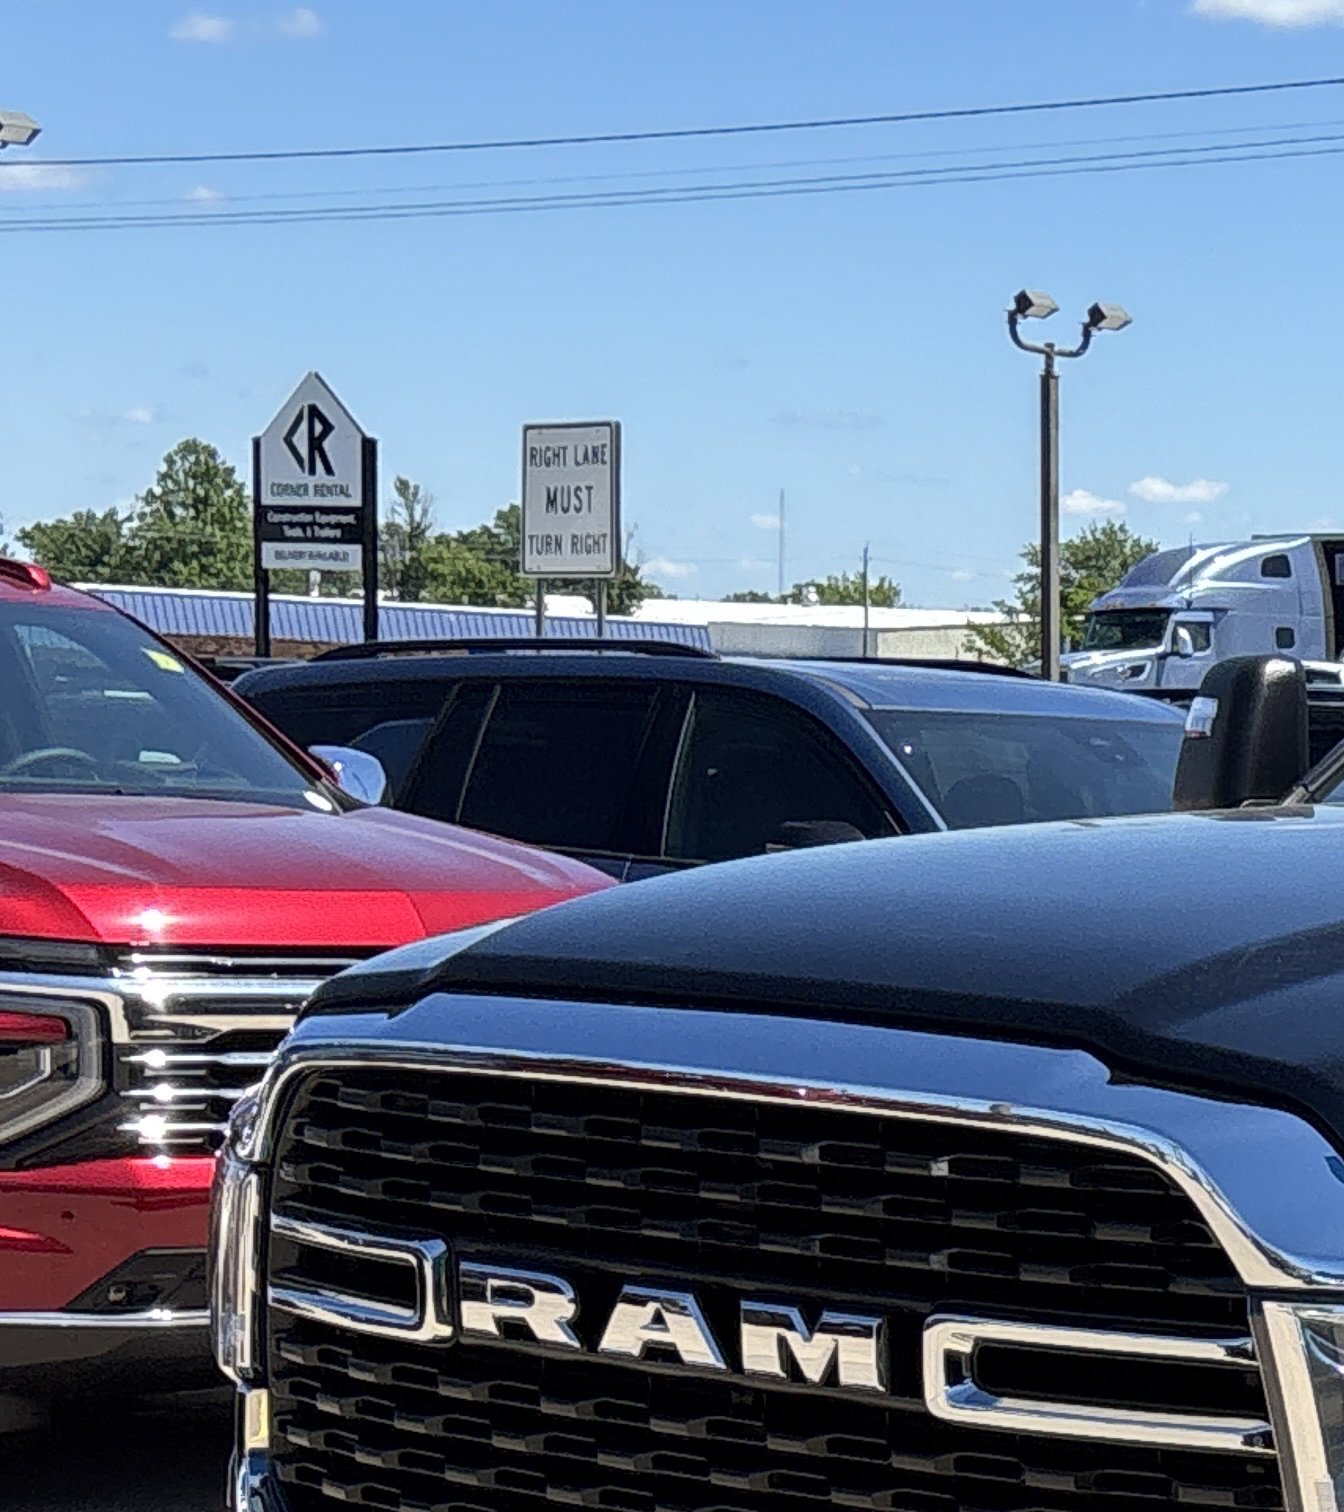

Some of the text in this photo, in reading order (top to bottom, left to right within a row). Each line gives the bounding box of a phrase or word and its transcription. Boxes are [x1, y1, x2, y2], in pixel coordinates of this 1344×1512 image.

[529, 443, 608, 468] RIGHT LANE
[545, 484, 594, 515] MUST
[528, 532, 608, 556] TURN RIGHT
[458, 1261, 887, 1394] RAM
